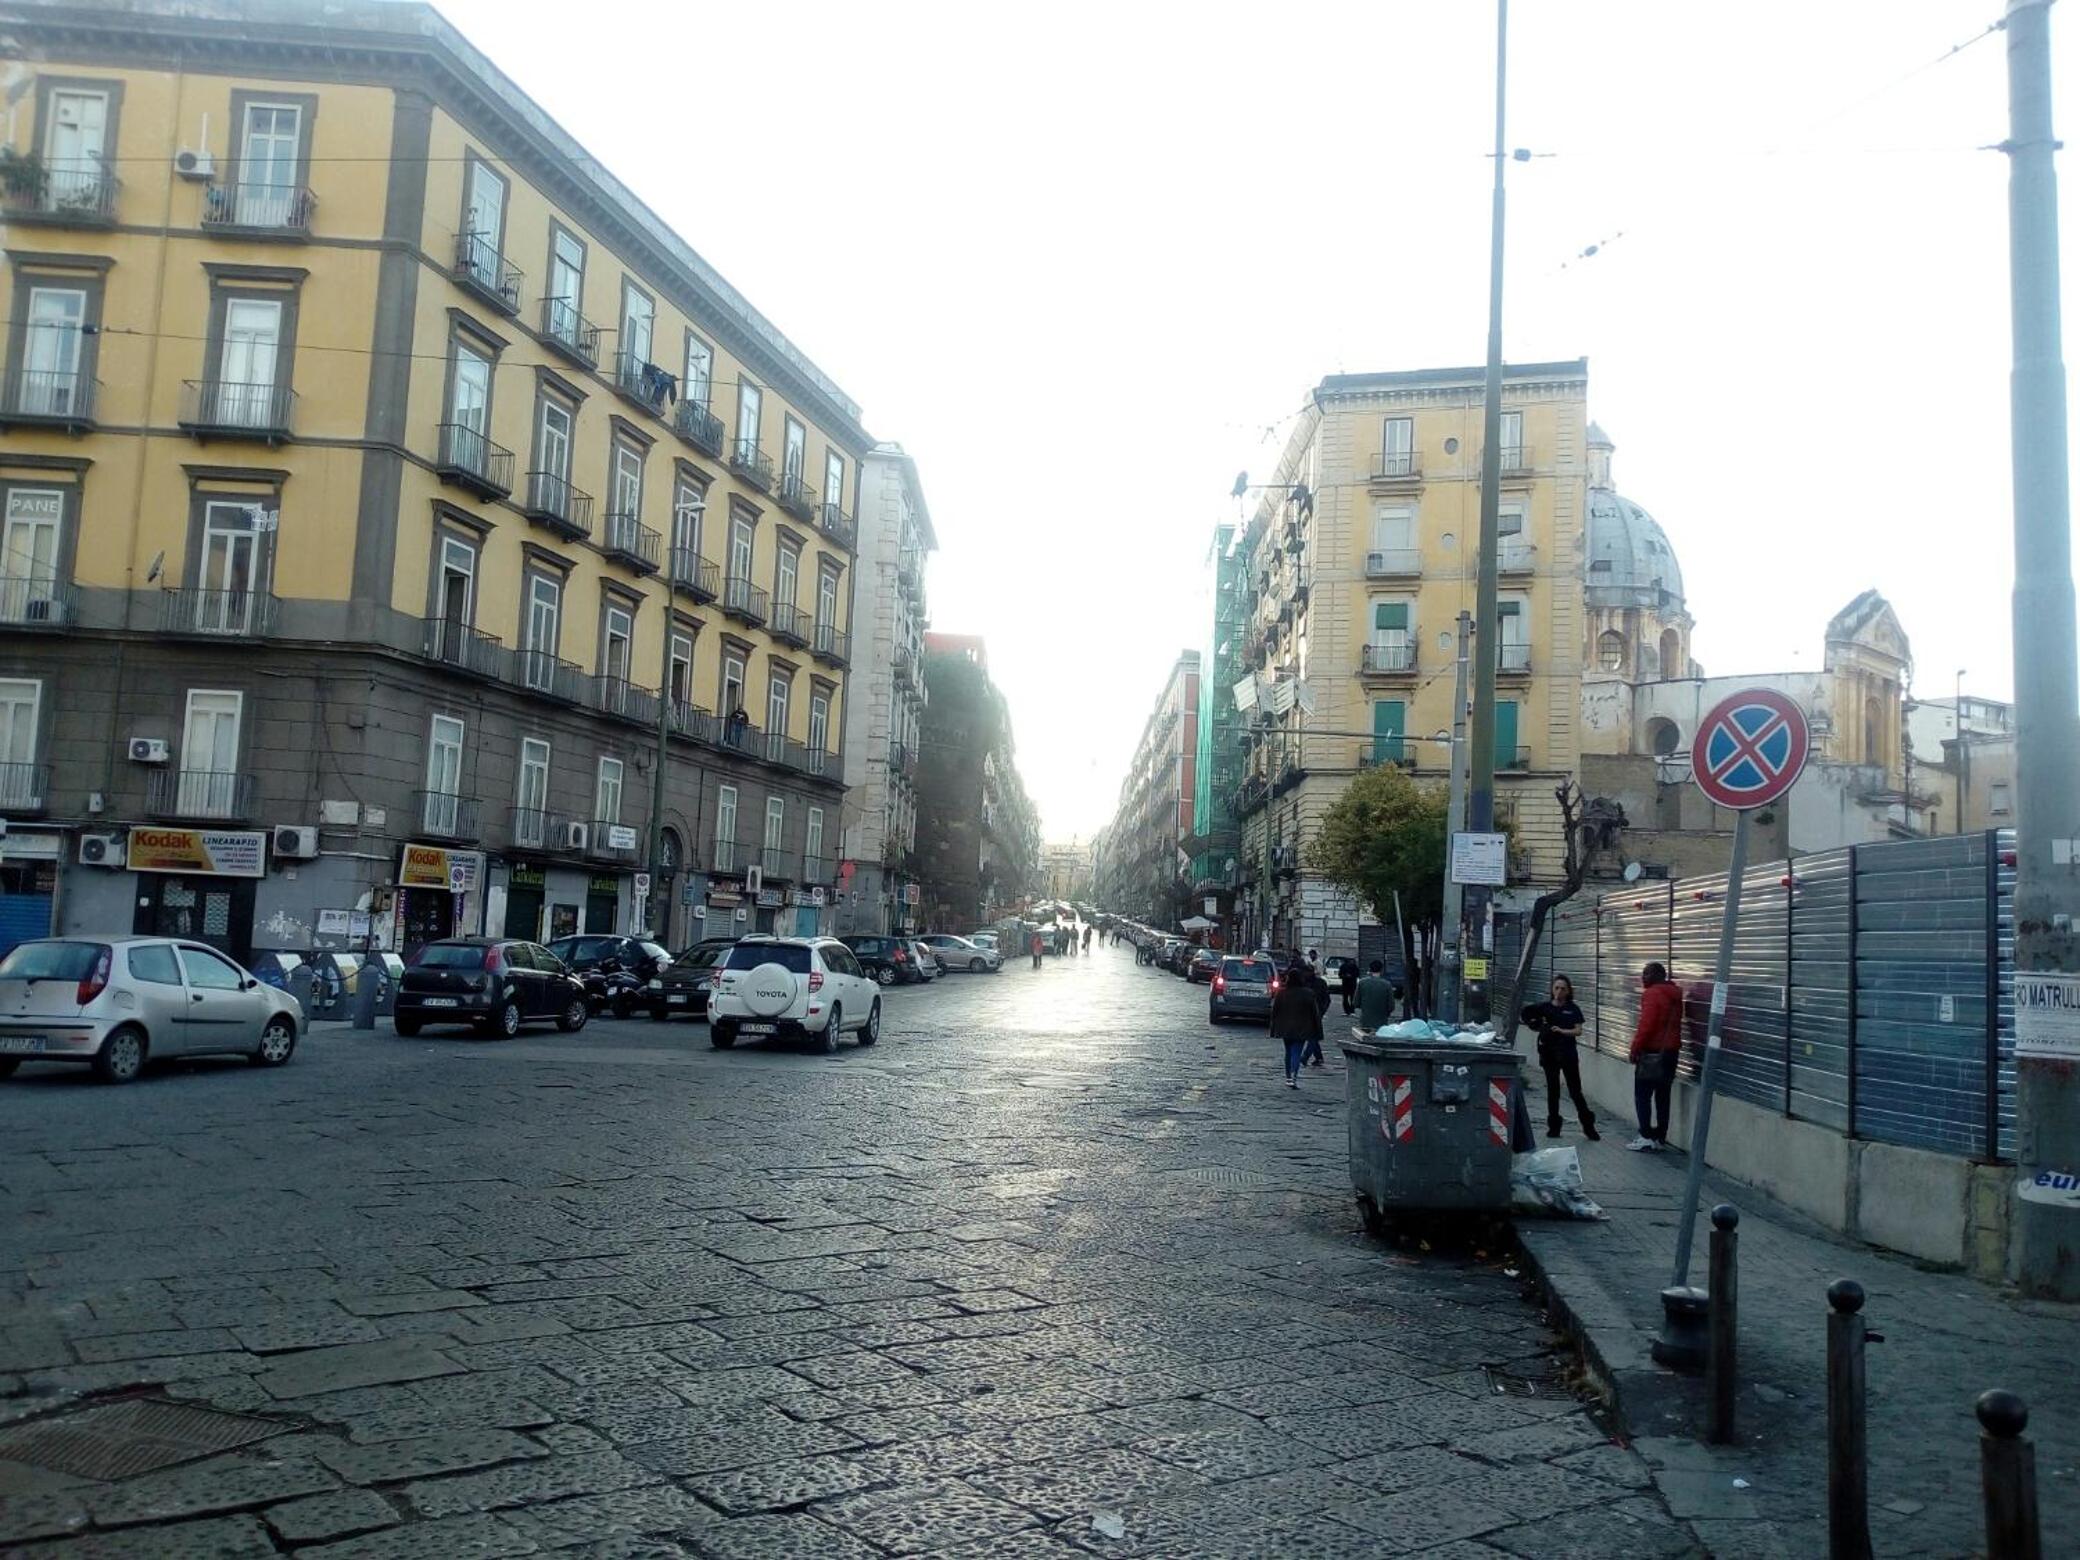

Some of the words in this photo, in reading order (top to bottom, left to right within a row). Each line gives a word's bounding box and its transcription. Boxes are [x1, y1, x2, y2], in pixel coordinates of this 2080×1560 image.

[12, 499, 58, 512] PANE
[135, 831, 193, 849] Kodak
[408, 847, 441, 867] Kodak
[755, 990, 787, 999] TOYOTA
